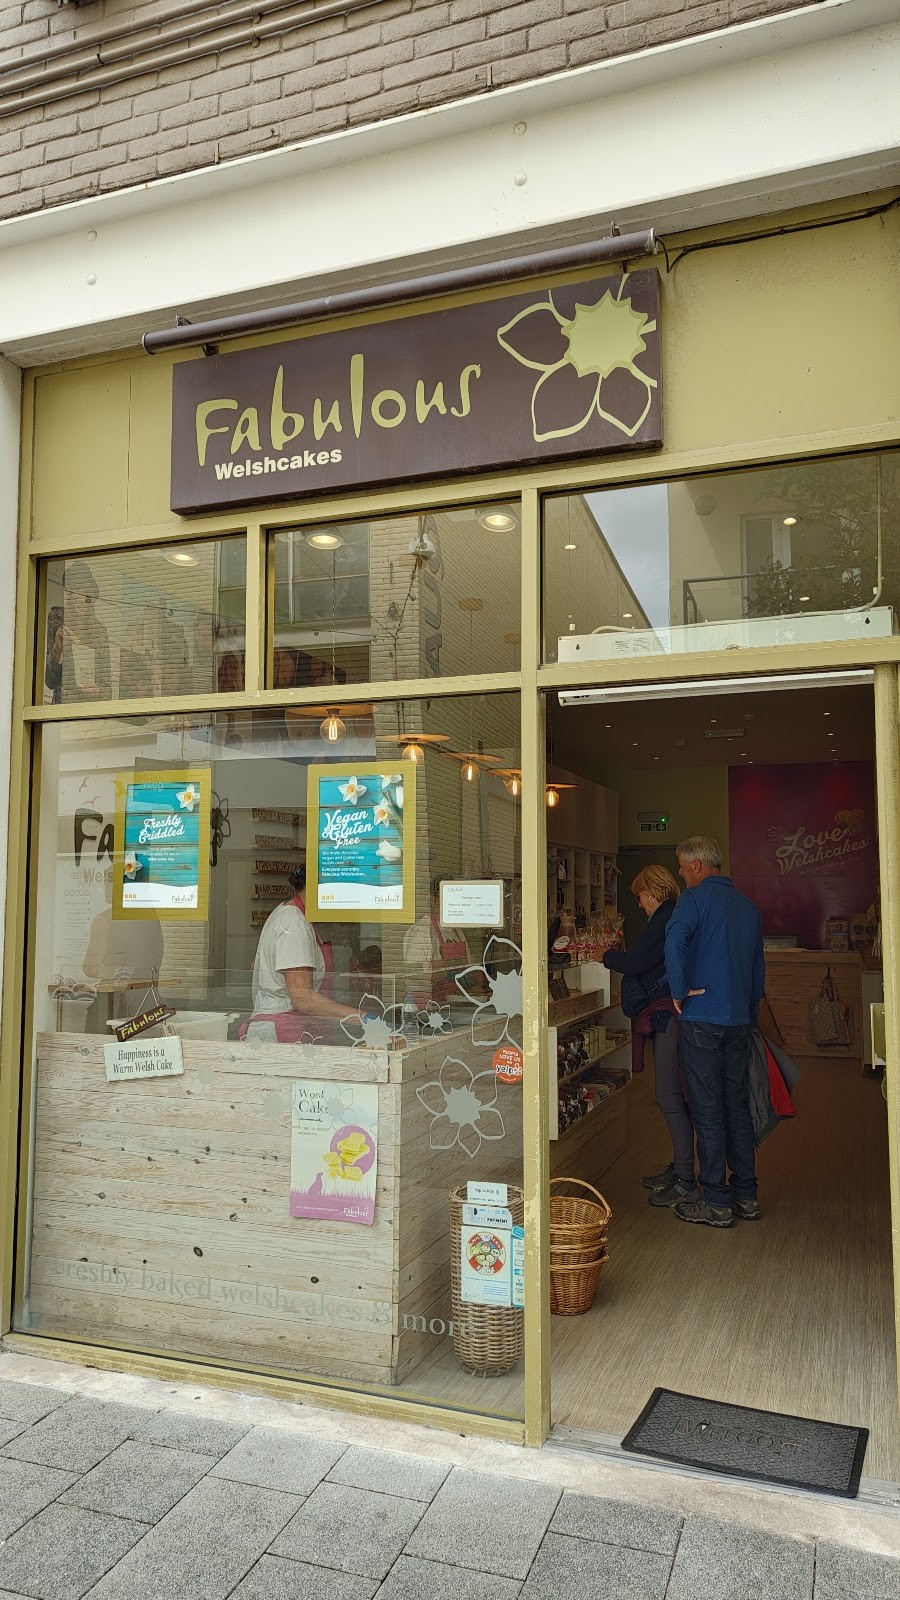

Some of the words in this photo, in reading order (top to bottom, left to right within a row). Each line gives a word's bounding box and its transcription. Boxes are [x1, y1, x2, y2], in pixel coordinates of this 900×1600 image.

[195, 354, 481, 466] Fabulous
[214, 448, 342, 480] Welshcakes
[143, 815, 182, 832] Freshly
[325, 809, 368, 830] Vegan
[138, 825, 185, 844] Griddled
[329, 823, 373, 841] Gluten
[776, 826, 845, 858] Love
[333, 837, 361, 849] Free
[776, 839, 868, 876] Welshcakes
[121, 1007, 164, 1039] Fabulous
[118, 1047, 153, 1062] Happiness
[153, 1046, 160, 1058] is
[160, 1048, 165, 1057] a
[113, 1063, 134, 1074] Warm
[135, 1060, 155, 1073] Welsh
[156, 1059, 173, 1071] Cake
[496, 1065, 514, 1075] yelp
[142, 1265, 212, 1299] baked
[221, 1285, 363, 1322] welshcakes
[401, 1312, 477, 1340] more
